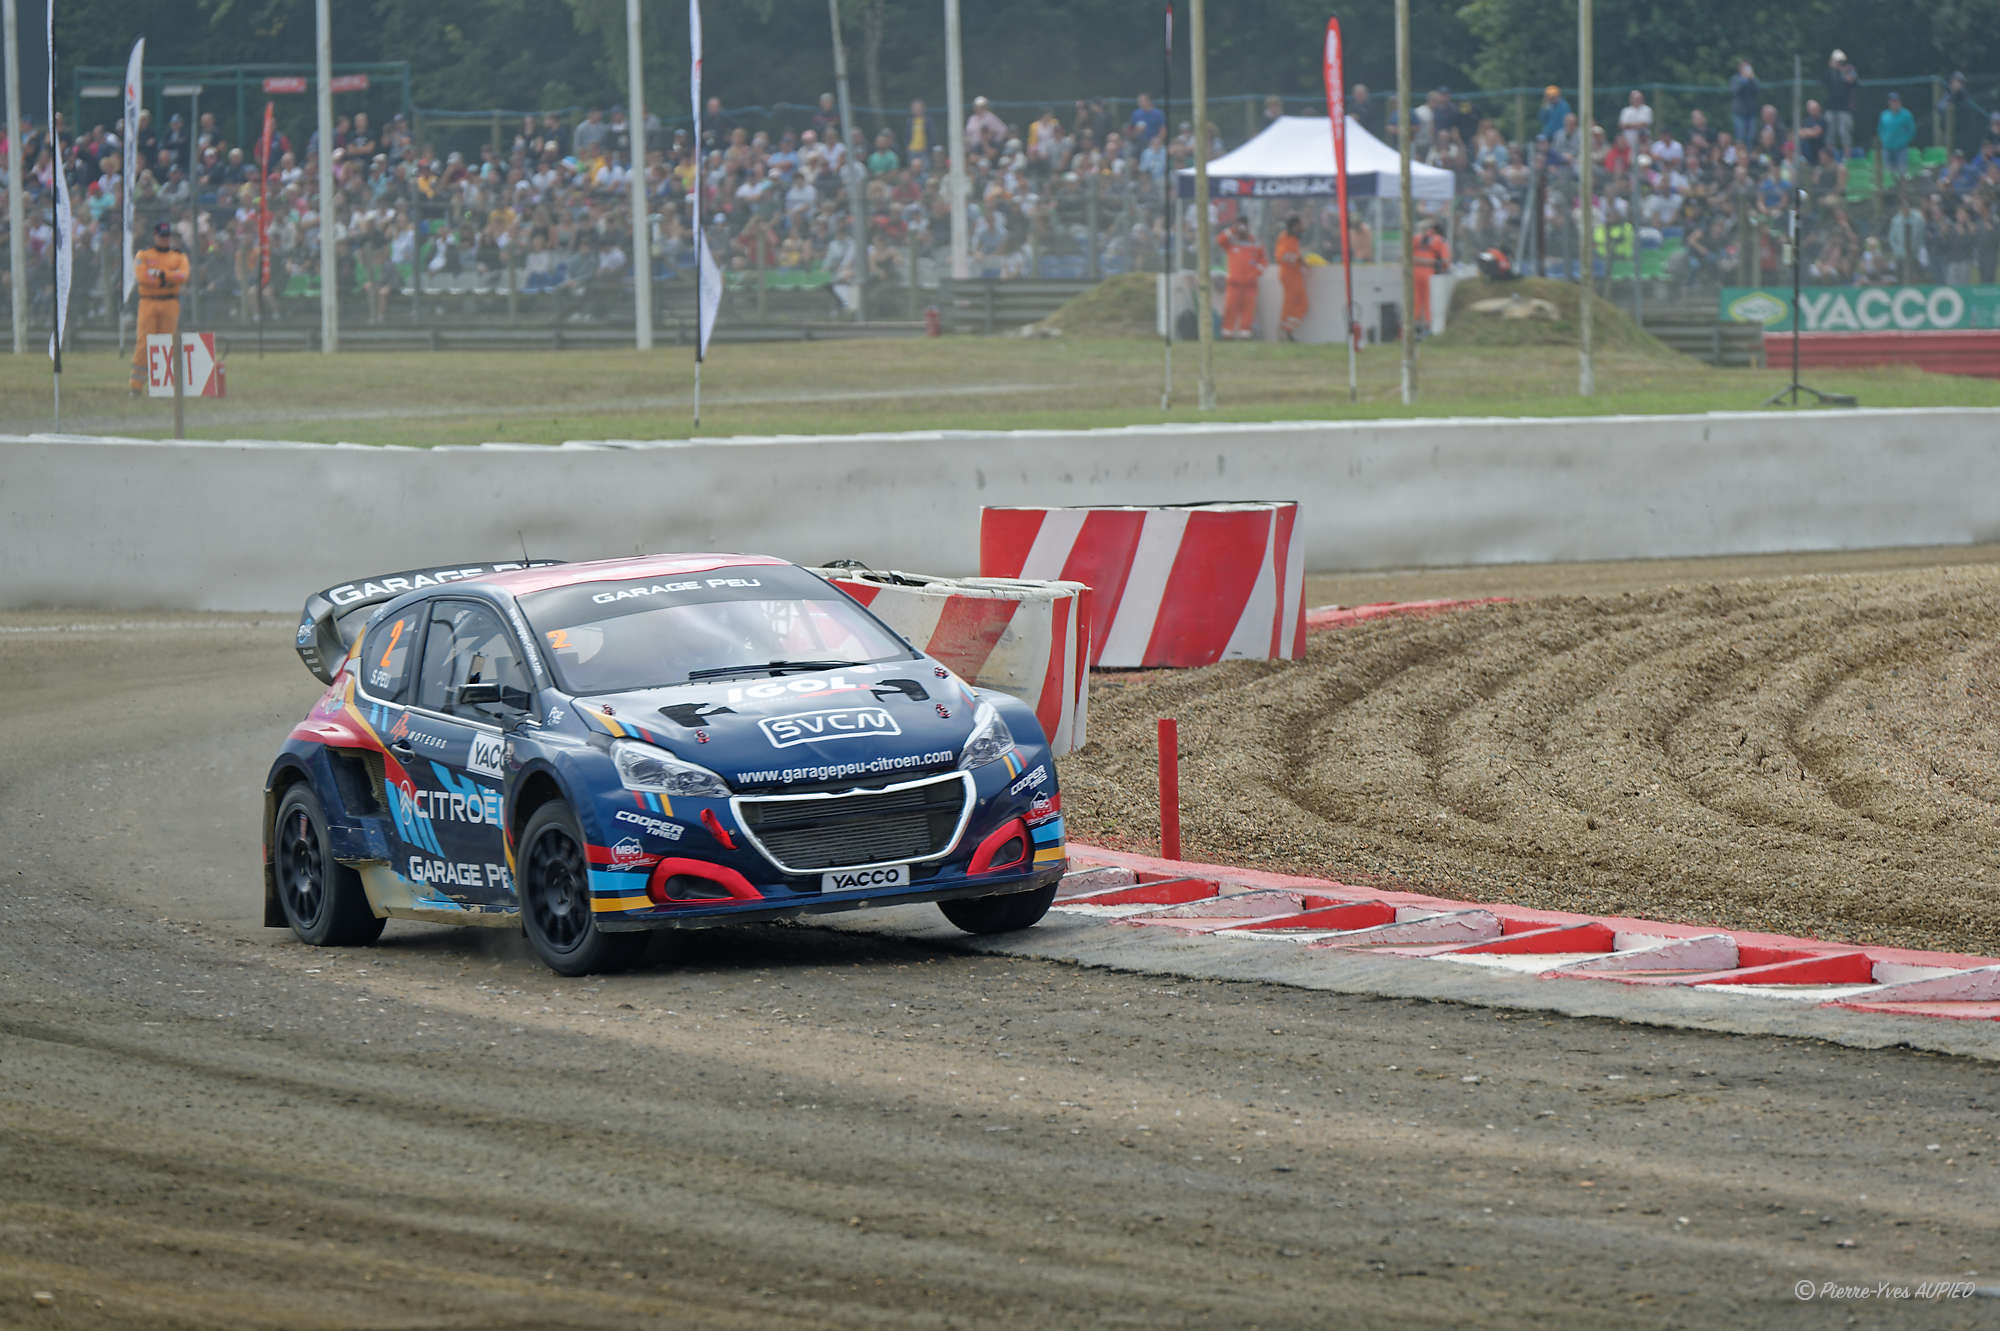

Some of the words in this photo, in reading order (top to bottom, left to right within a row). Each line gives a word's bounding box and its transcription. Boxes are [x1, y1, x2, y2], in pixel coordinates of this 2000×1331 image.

[1799, 287, 1964, 329] YACCO
[149, 344, 194, 387] EXT
[592, 581, 702, 604] GARAGE
[705, 578, 761, 588] PEU
[380, 619, 404, 667] 2
[546, 629, 573, 649] 2
[728, 676, 857, 703] IGOL
[771, 713, 888, 739] SVCM
[737, 750, 953, 784] www.garagepeu-citroen.com
[615, 810, 685, 835] COOPER
[646, 827, 681, 841] TIRES
[409, 855, 483, 886] GARAGE
[832, 869, 899, 888] YACCO
